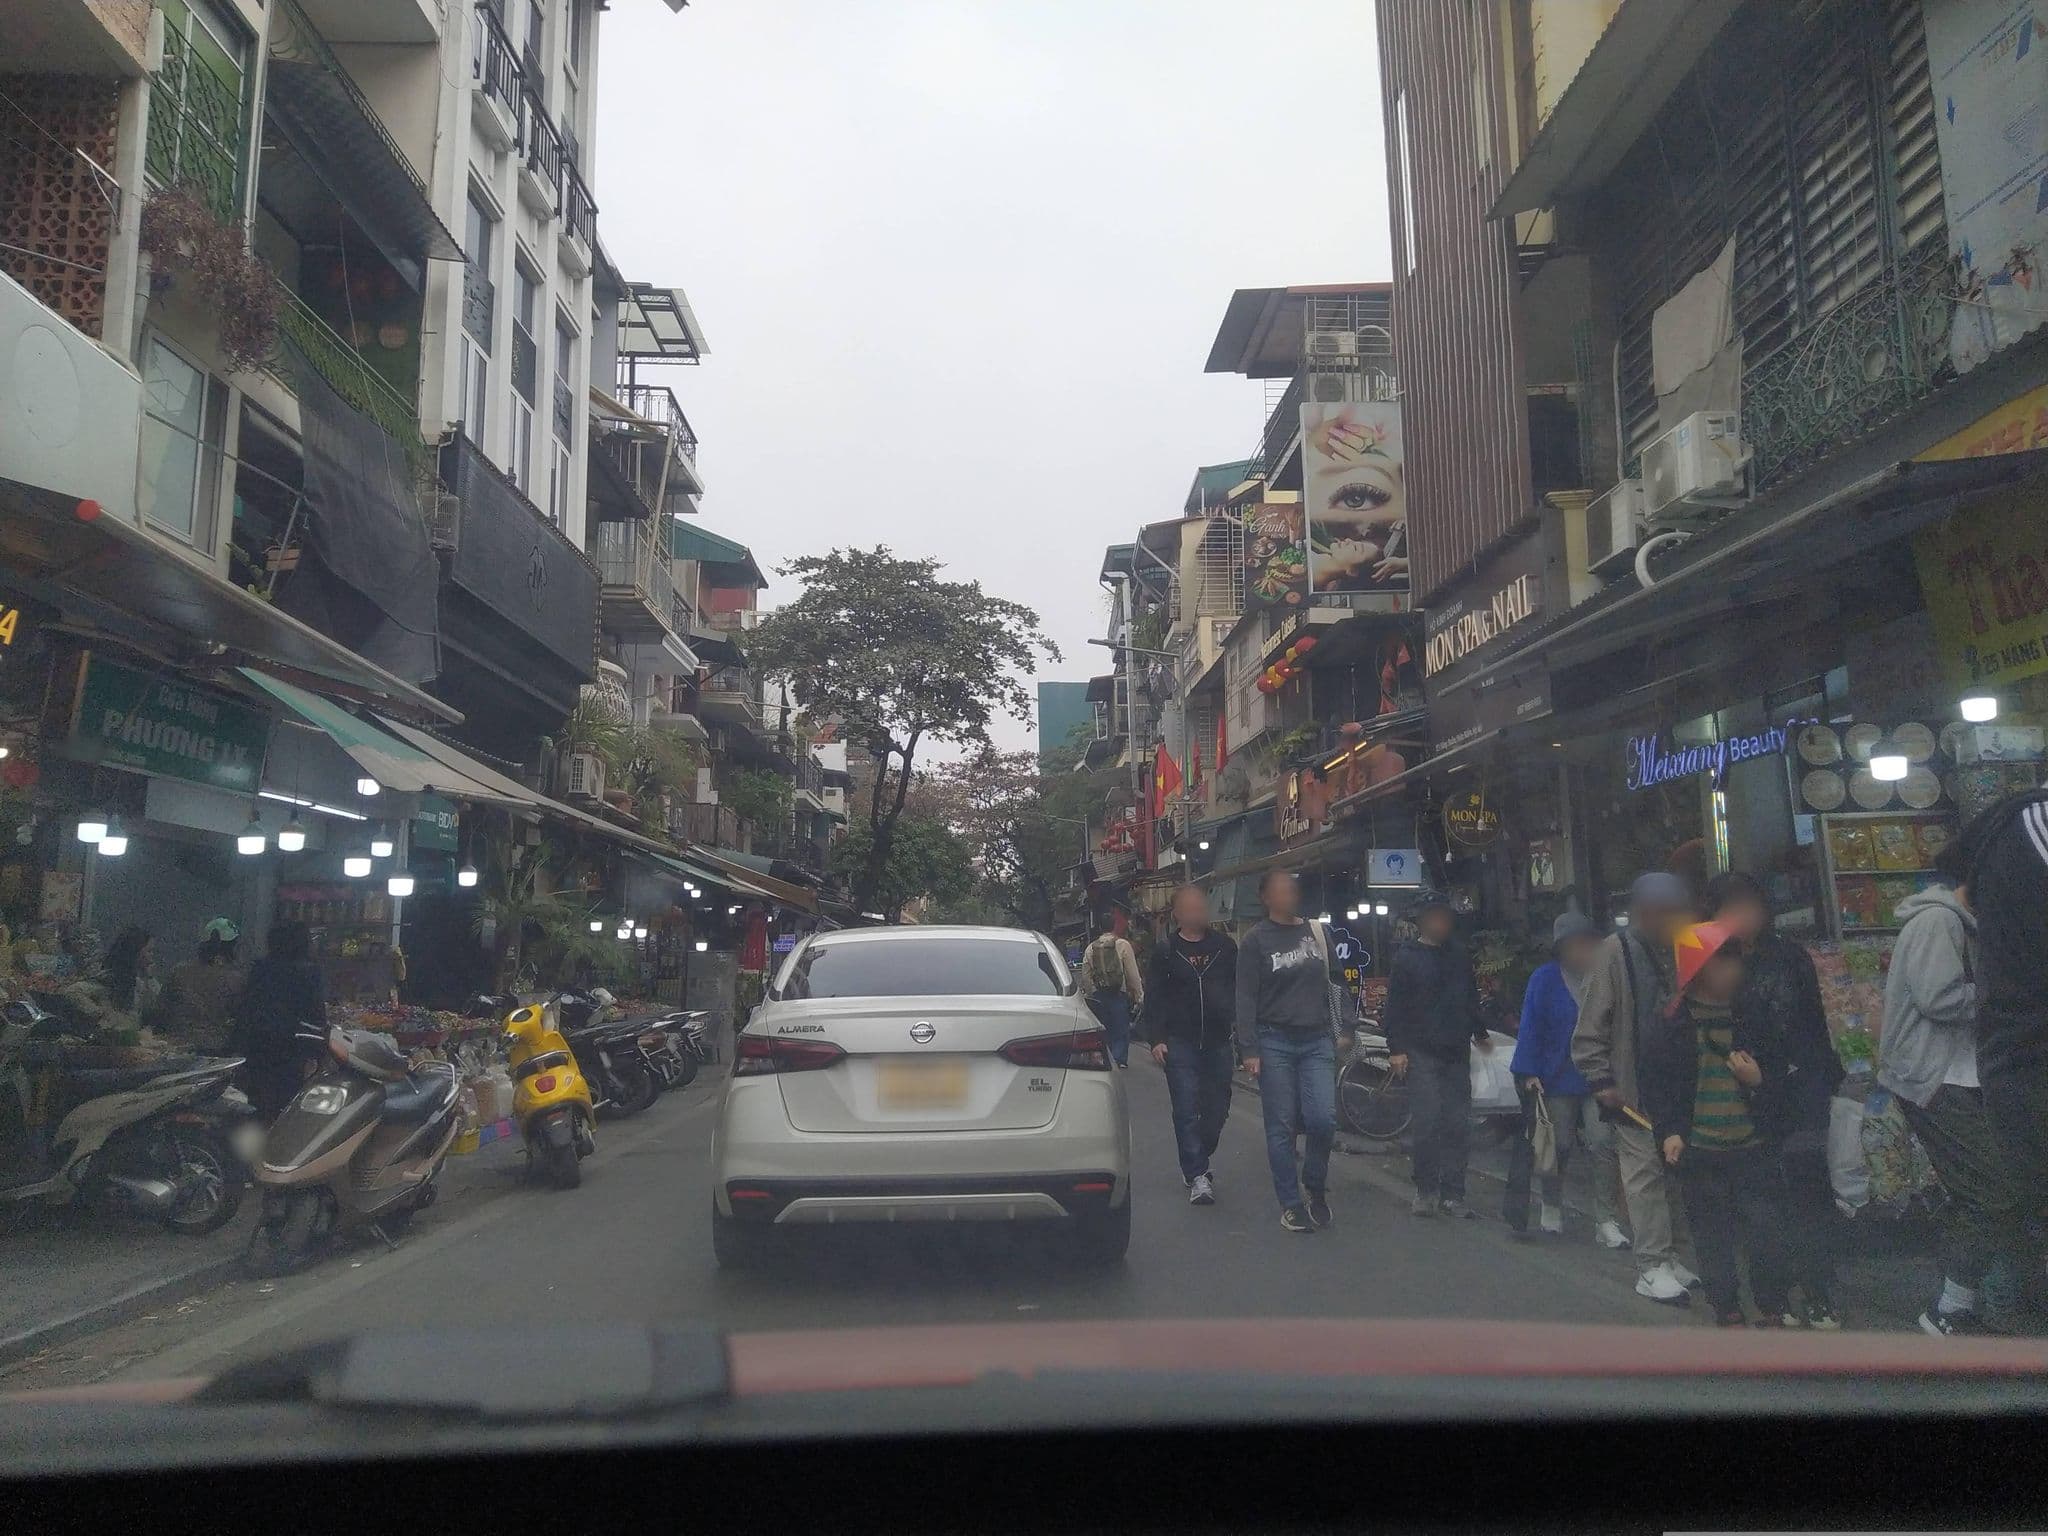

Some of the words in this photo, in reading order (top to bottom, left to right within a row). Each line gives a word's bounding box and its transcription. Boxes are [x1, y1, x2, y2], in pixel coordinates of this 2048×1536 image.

[0, 604, 18, 645] A
[1425, 626, 1457, 678] MON
[1457, 610, 1481, 658] SPA
[1481, 611, 1492, 642] &
[1492, 574, 1533, 636] NAIL
[1729, 726, 1786, 762] Beauty
[1451, 810, 1476, 822] MON
[777, 1025, 826, 1034] ALMERA
